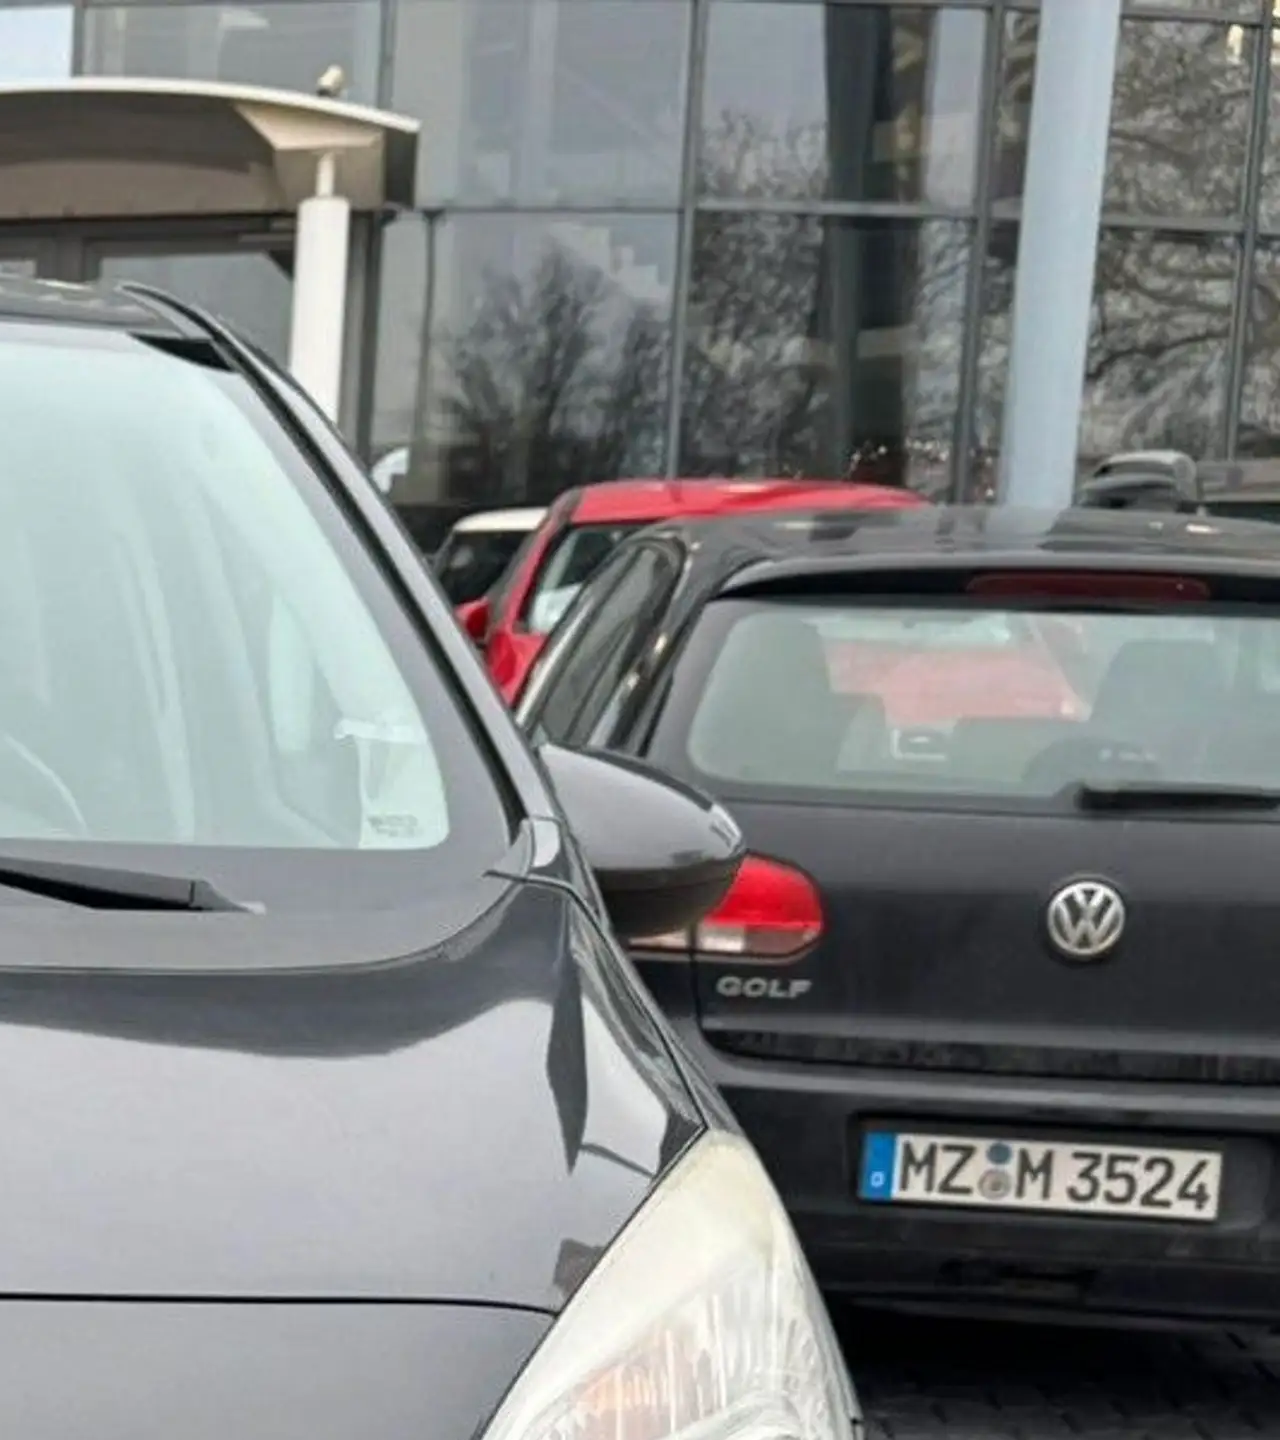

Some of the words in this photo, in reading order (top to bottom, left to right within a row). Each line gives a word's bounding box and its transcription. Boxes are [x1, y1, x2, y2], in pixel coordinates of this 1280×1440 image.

[716, 976, 812, 998] GOLF
[899, 1142, 977, 1195] MZ
[1015, 1148, 1054, 1198] M
[1066, 1152, 1211, 1209] 3524
